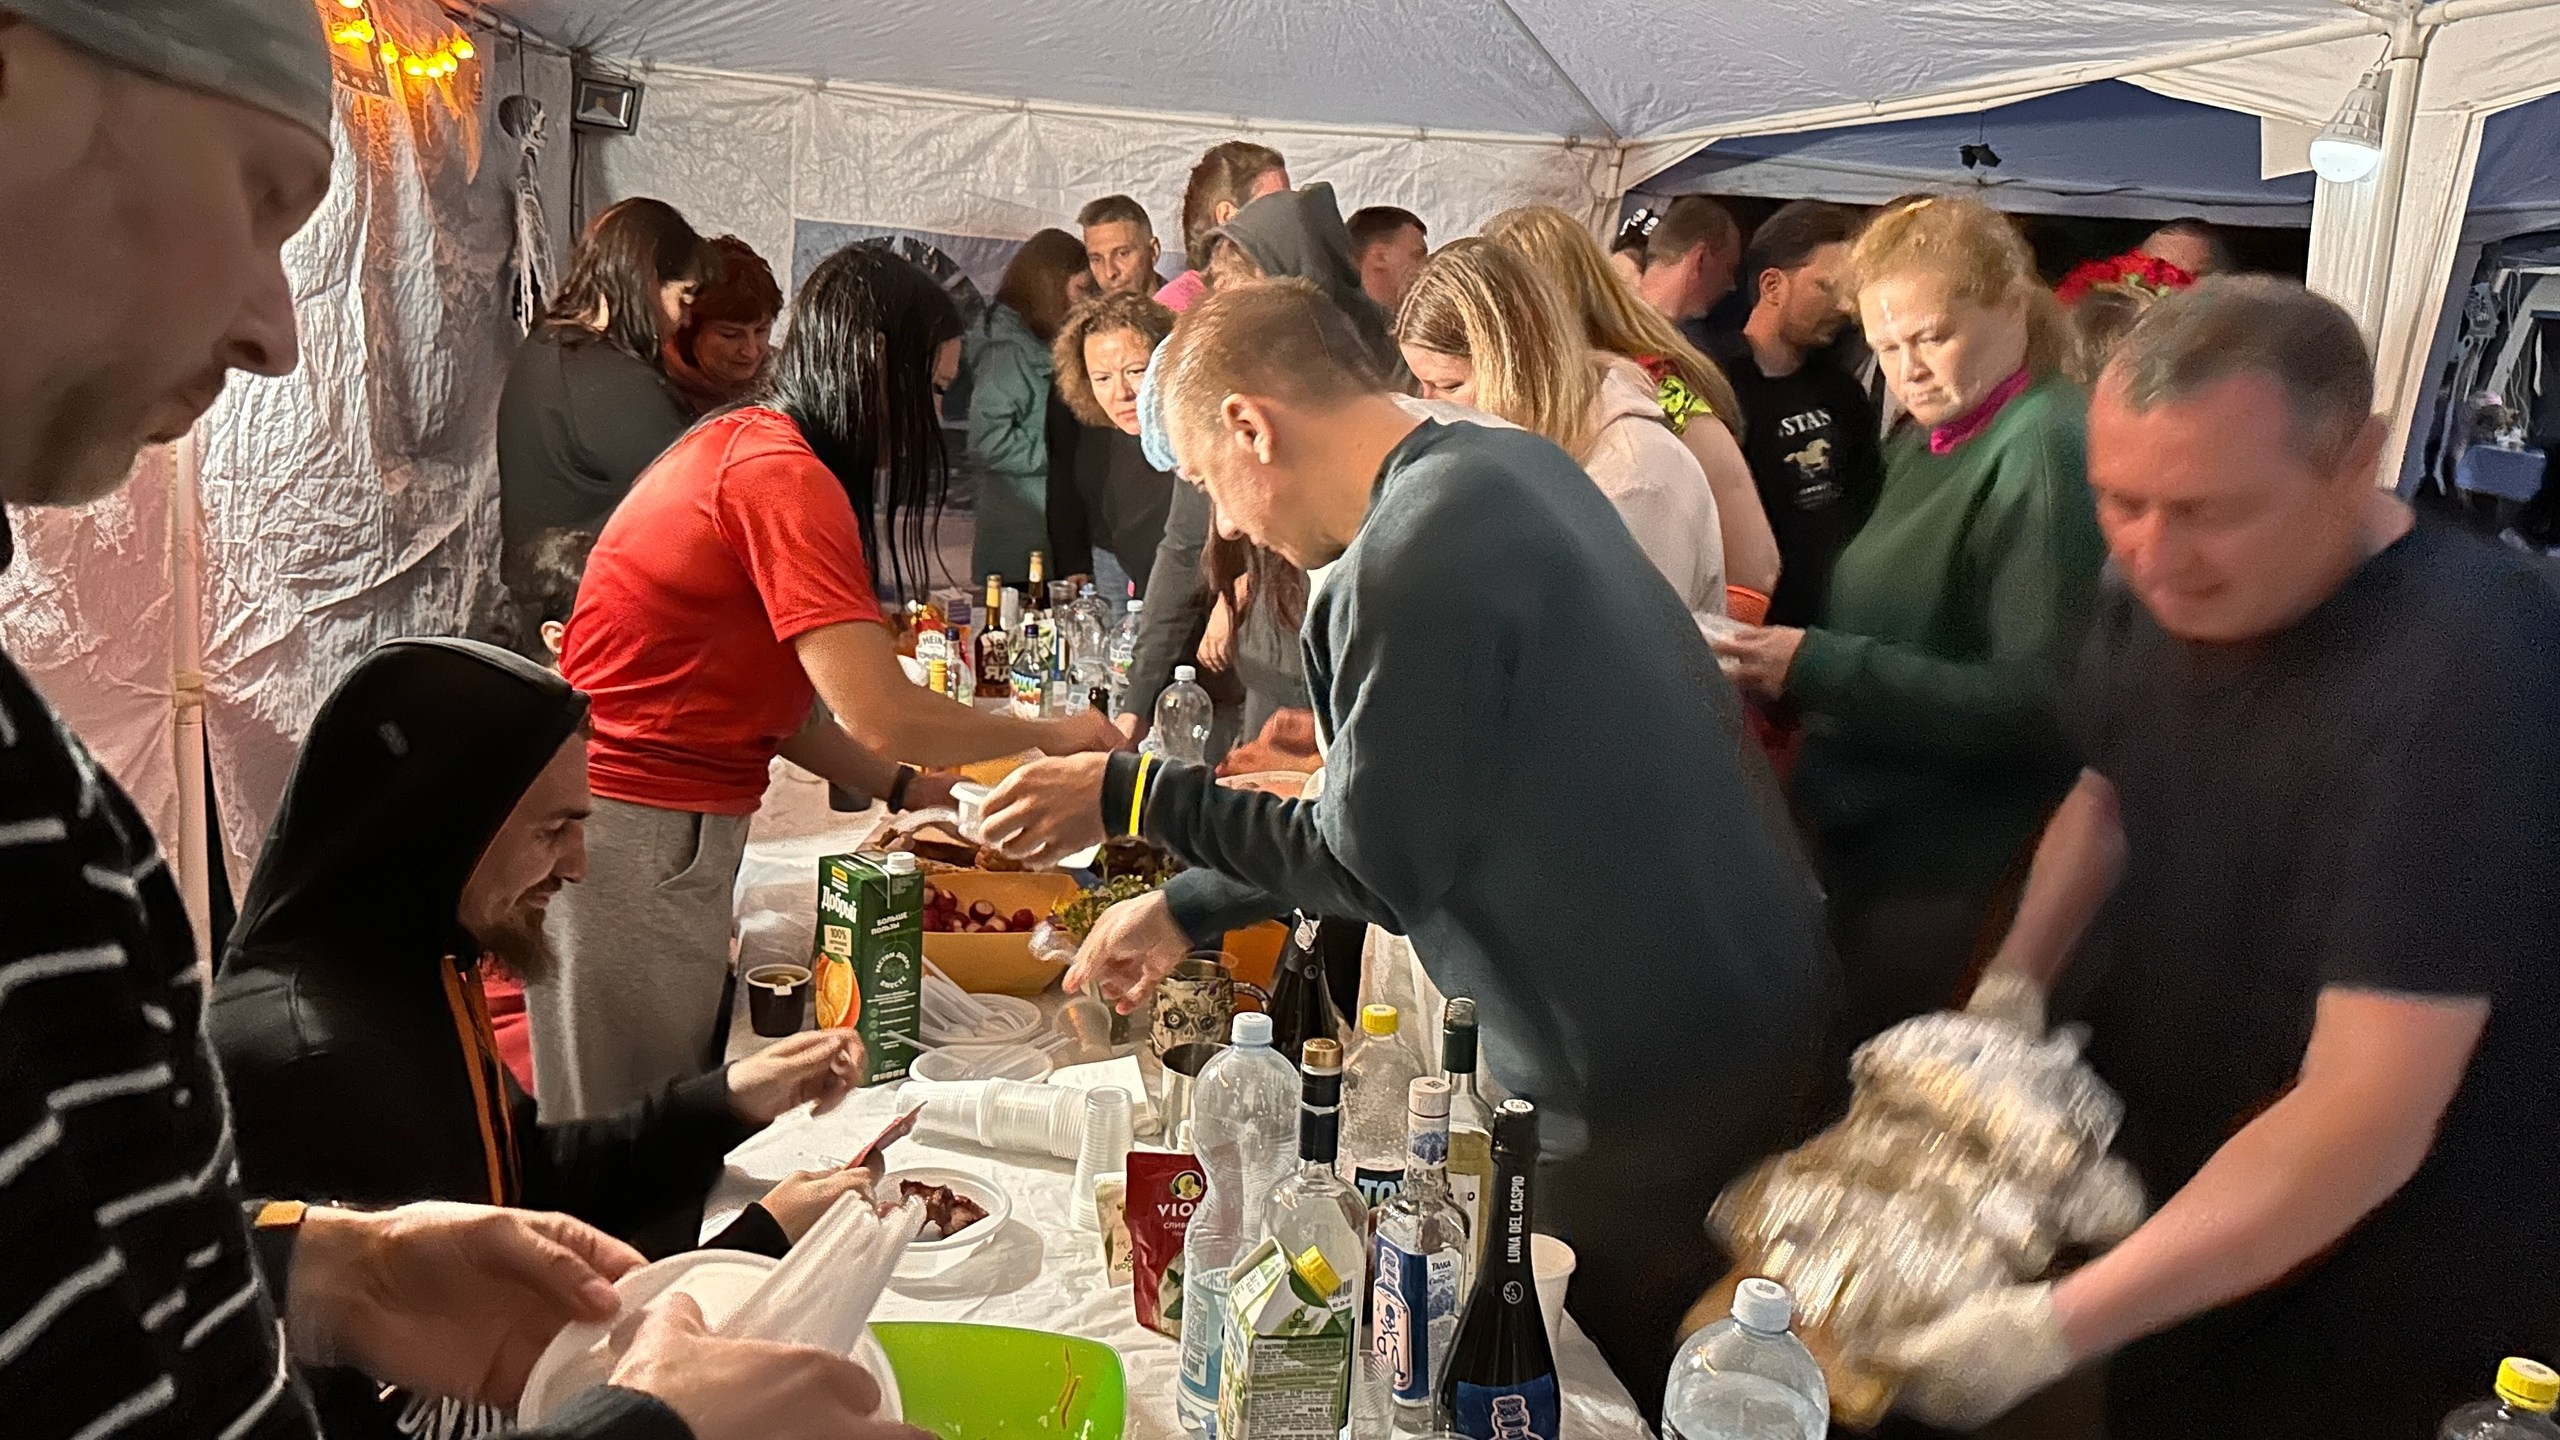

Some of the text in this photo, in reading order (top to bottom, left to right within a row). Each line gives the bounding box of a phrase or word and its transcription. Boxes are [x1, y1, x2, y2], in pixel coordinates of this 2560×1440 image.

[821, 885, 857, 924] Добрый
[877, 911, 908, 927] БОЛЬШЕ
[830, 928, 847, 940] 100%
[871, 922, 900, 935] ПОЛЬЗЫ
[875, 951, 910, 973] РАСТИМ ДОБРО
[880, 975, 907, 989] ВМЕСТЕ
[1507, 1175, 1525, 1263] LUNA DEL CASPIO
